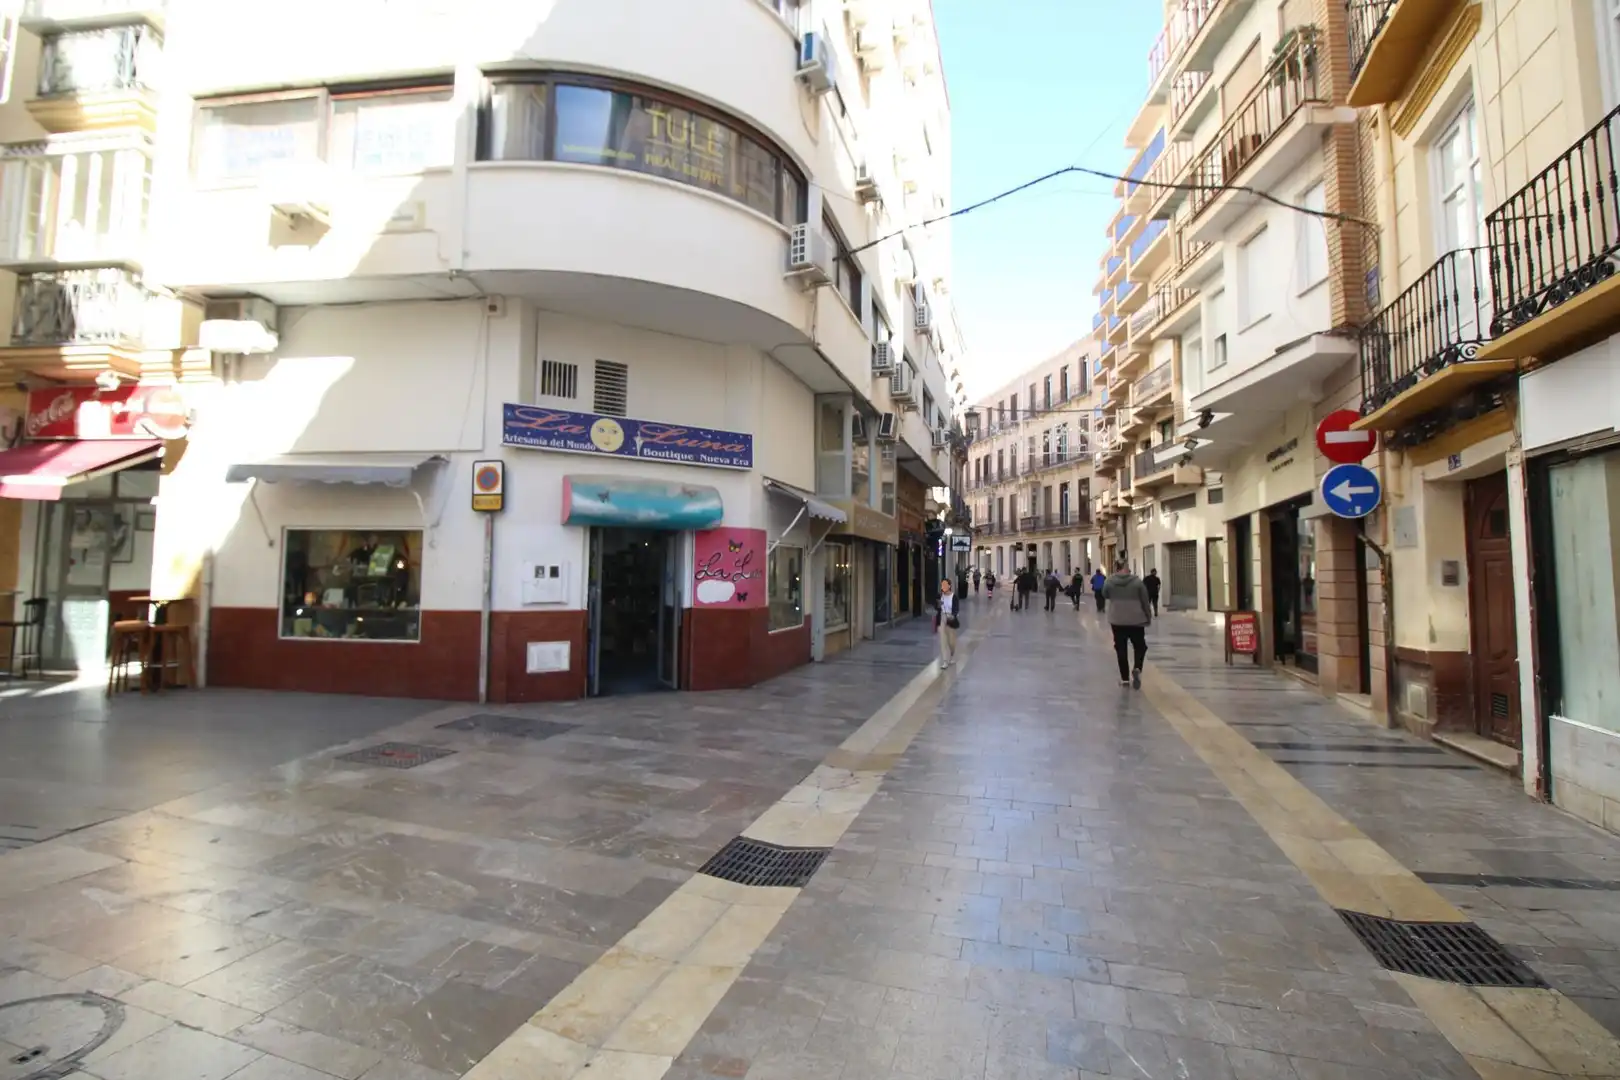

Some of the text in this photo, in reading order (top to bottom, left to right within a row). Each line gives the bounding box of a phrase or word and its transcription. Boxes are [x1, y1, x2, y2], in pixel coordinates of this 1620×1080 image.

[549, 437, 565, 448] del
[566, 439, 596, 451] Mundo
[640, 424, 746, 452] Luna
[643, 448, 749, 466] Boutique Nueva Era
[695, 552, 731, 580] La
